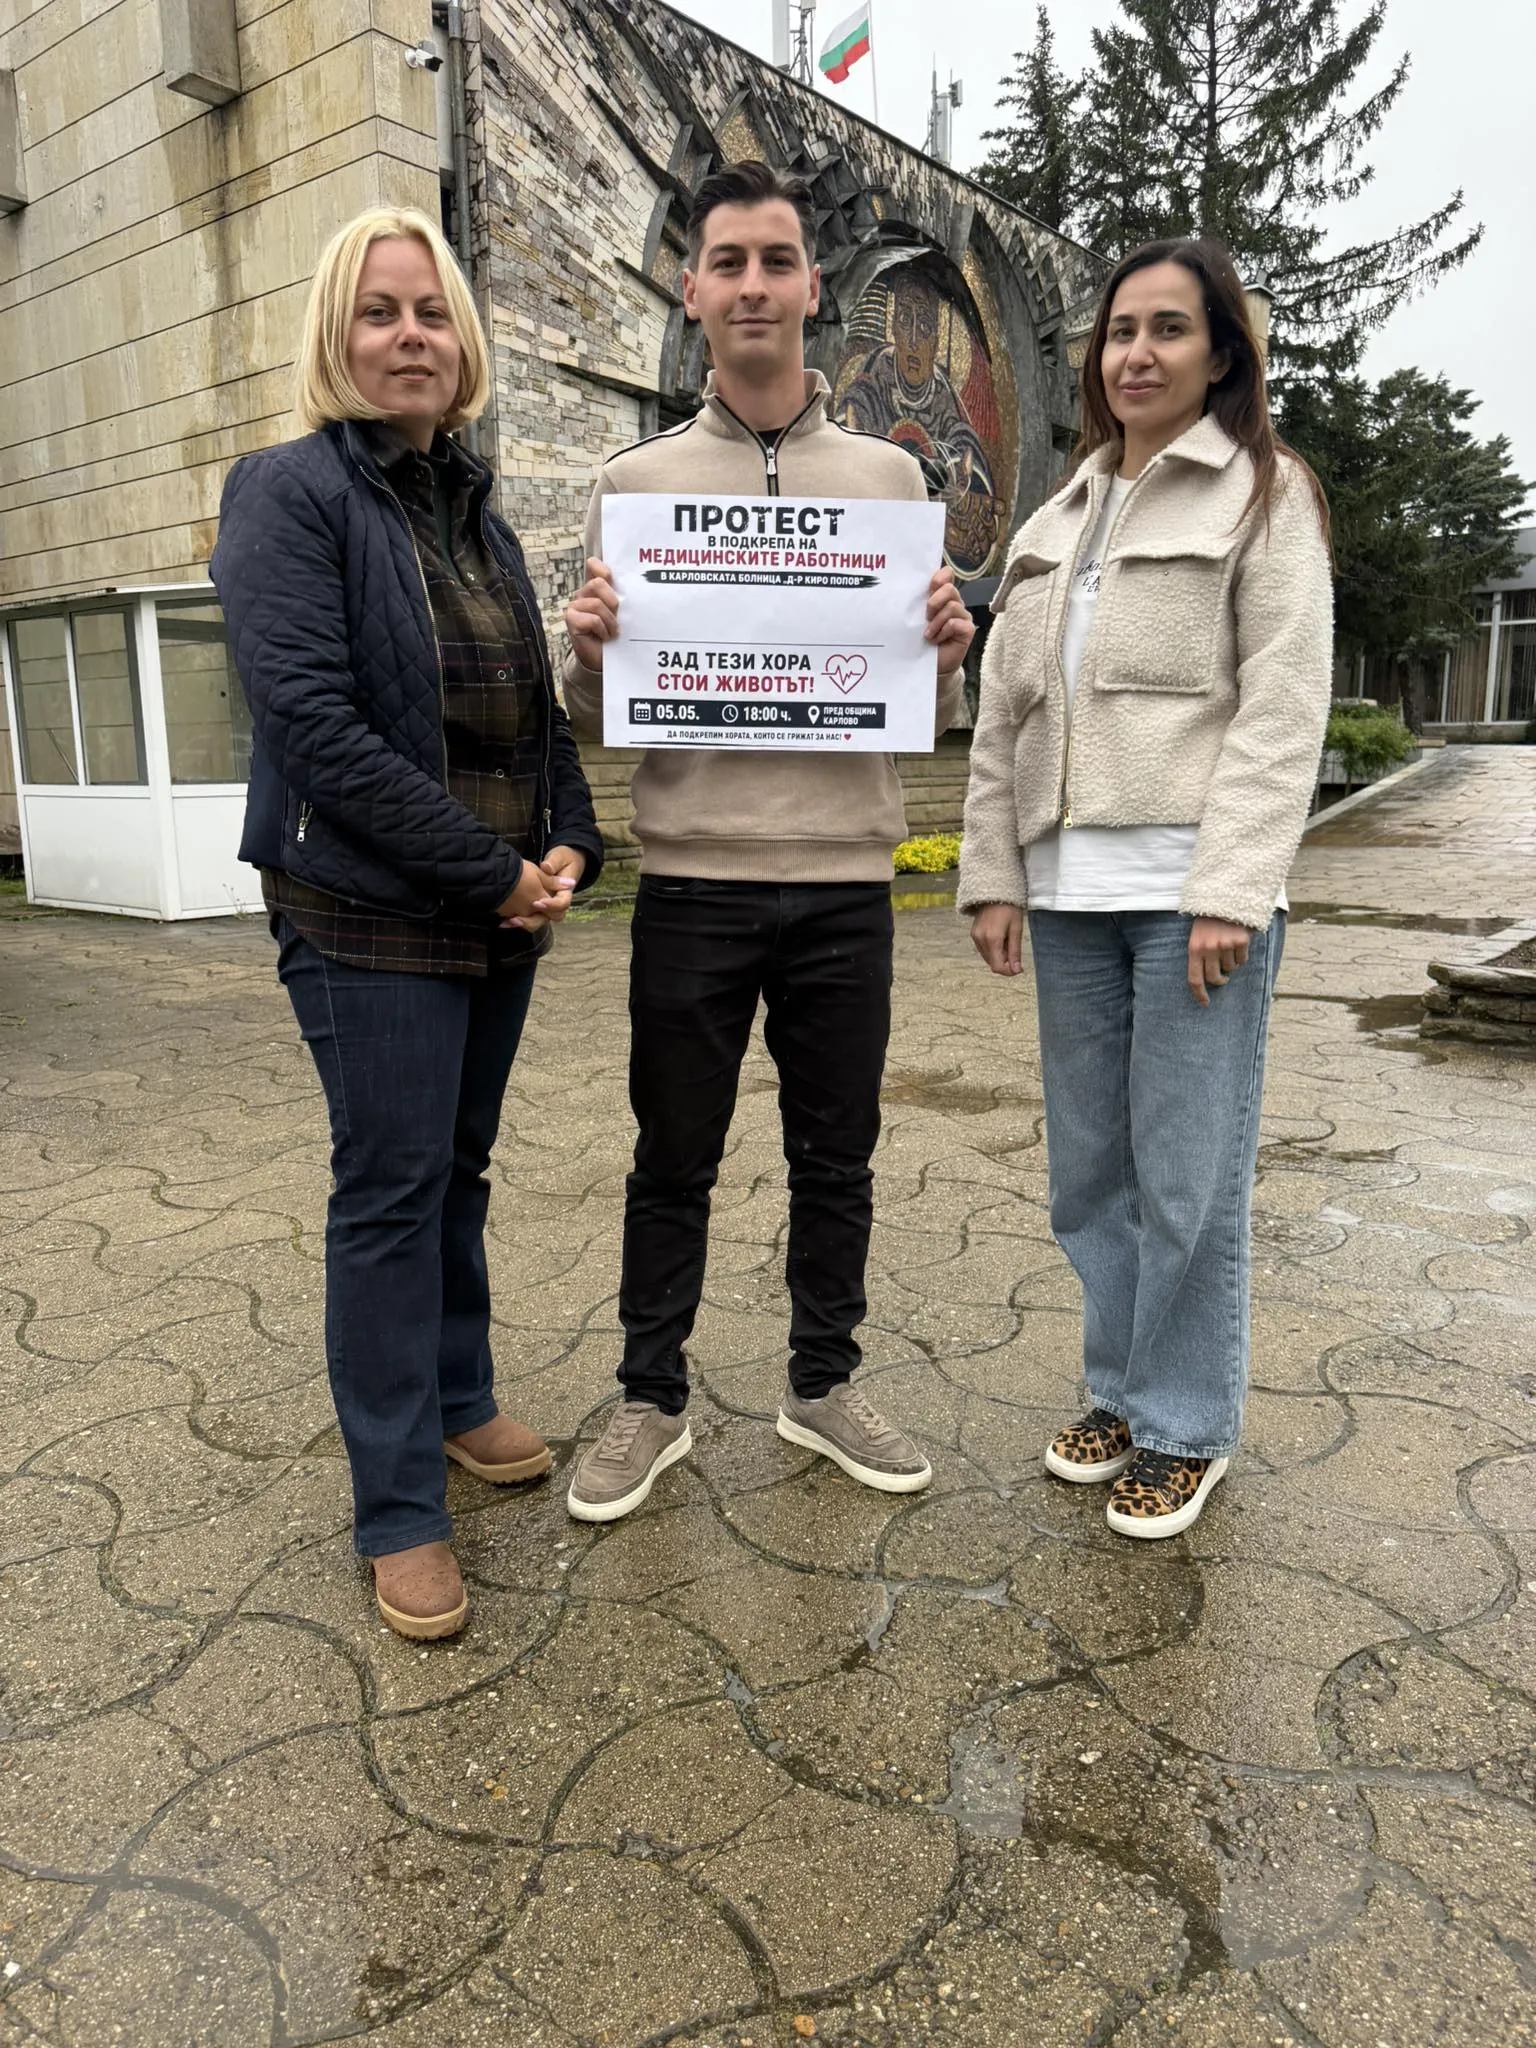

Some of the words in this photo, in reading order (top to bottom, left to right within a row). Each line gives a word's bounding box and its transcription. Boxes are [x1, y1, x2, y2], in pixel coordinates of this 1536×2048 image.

[674, 504, 845, 536] ПРОТЕСТ
[708, 535, 716, 547] В
[720, 535, 795, 549] ПОДКРЕПА
[799, 538, 817, 549] НА
[639, 548, 780, 566] МЕДИЦИНСКИТЕ
[784, 551, 886, 571] РАБОТНИЦИ
[661, 572, 667, 580] В
[669, 572, 736, 582] КАРЛОВСКАТА
[738, 574, 781, 584] БОЛНИЦА
[805, 576, 828, 585] КИРО
[657, 651, 699, 671] ЗАД
[705, 652, 755, 669] ТЕЗИ
[761, 653, 811, 671] ХОРА
[657, 673, 708, 692] СТОИ
[716, 674, 815, 693] ЖИВОТЪТ!
[656, 704, 700, 720] 05.05.
[743, 706, 778, 721] 18:00
[781, 711, 792, 722] ч.
[823, 706, 844, 715] ПРЕД
[845, 706, 877, 716] ОБЩИНА
[823, 716, 859, 725] КАРЛОВО
[667, 730, 677, 738] ДА
[679, 730, 723, 740] ПОДКРЕПИМ
